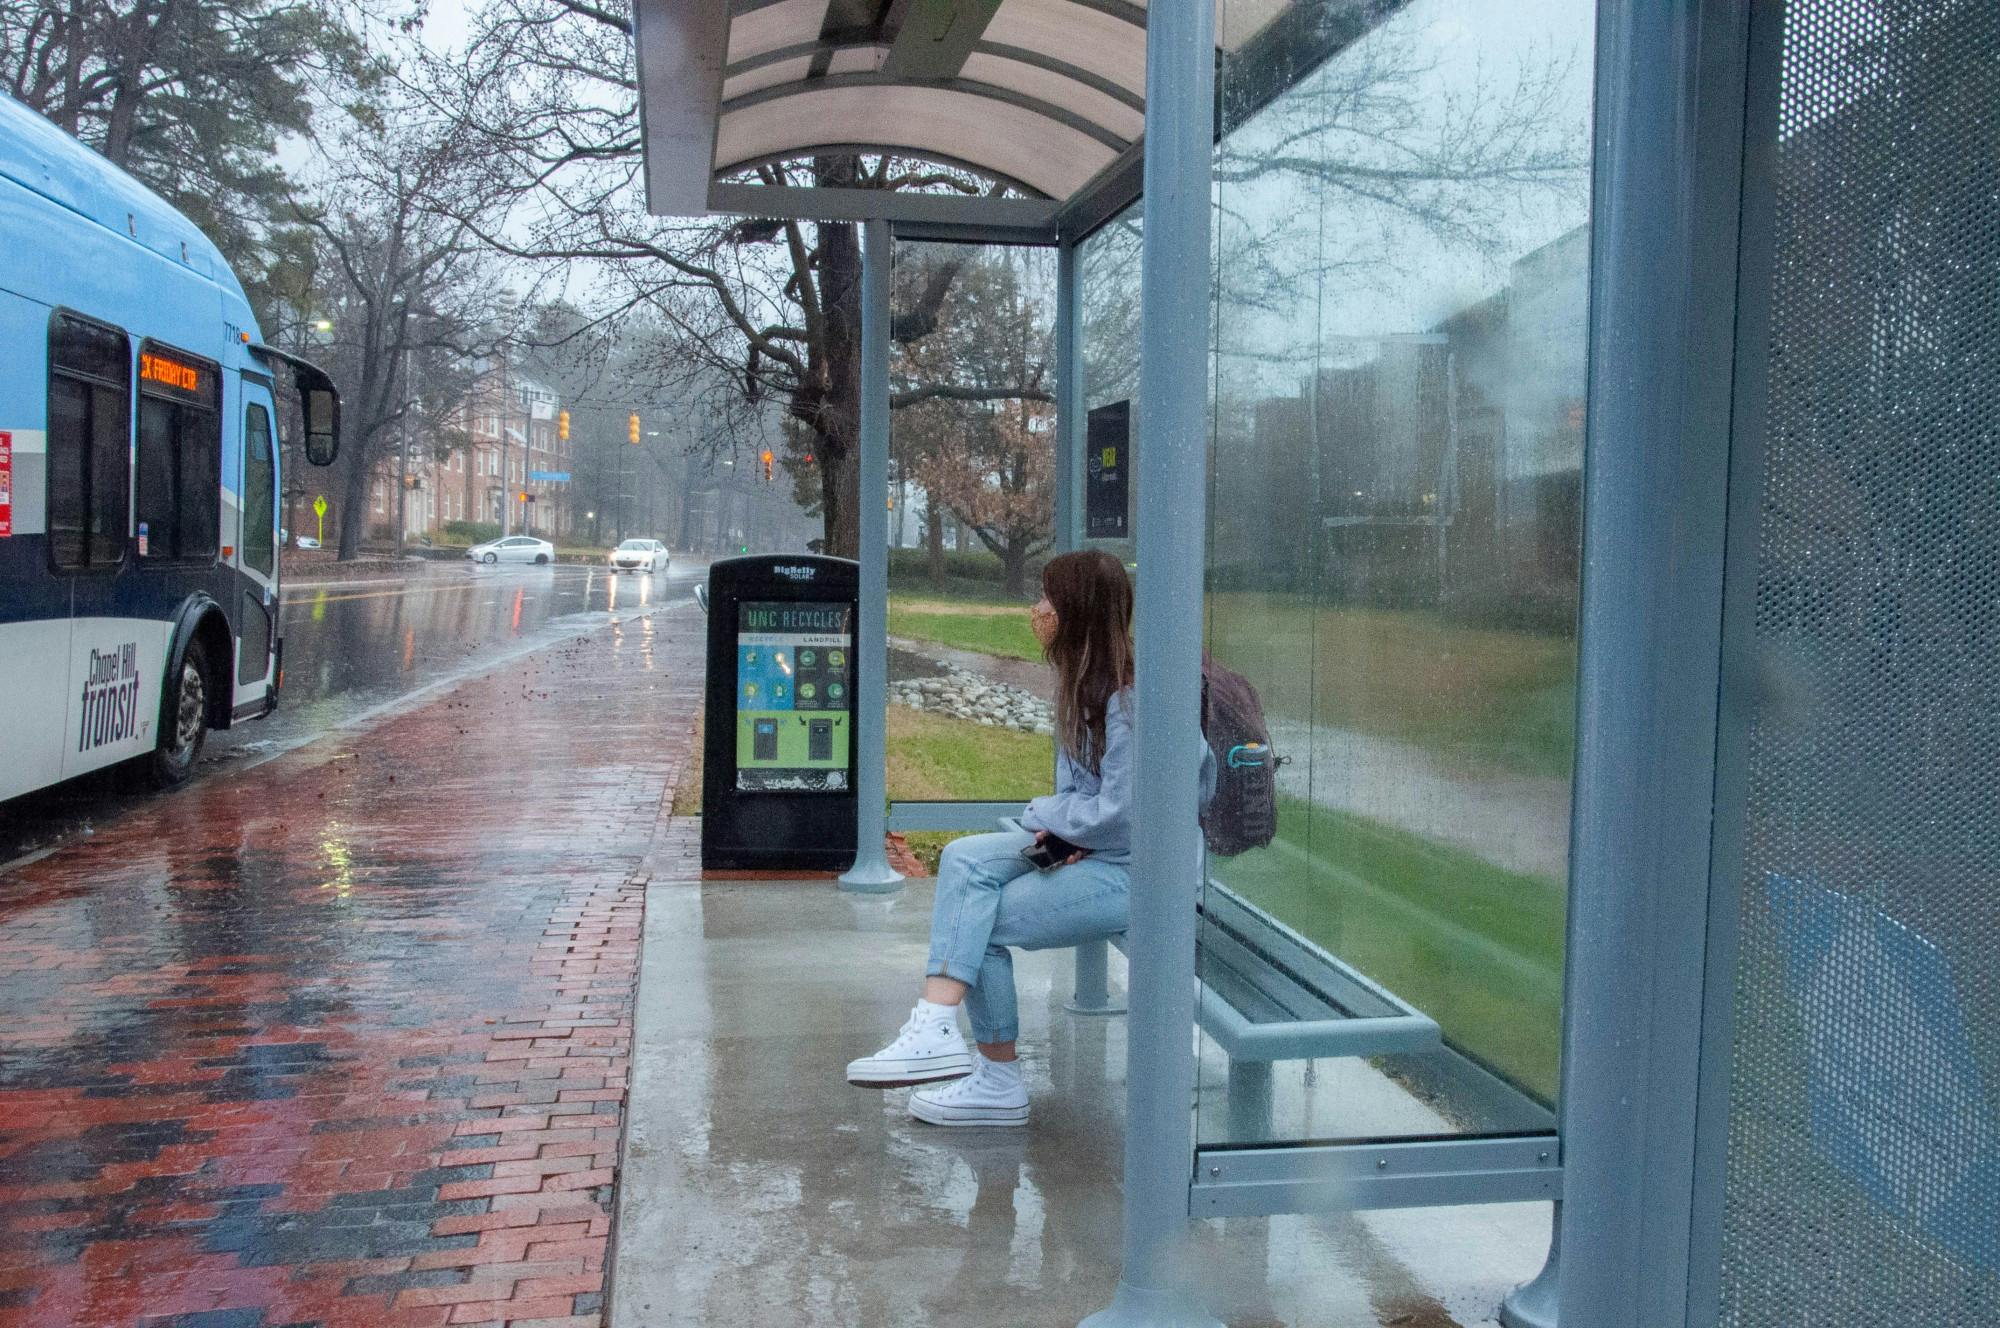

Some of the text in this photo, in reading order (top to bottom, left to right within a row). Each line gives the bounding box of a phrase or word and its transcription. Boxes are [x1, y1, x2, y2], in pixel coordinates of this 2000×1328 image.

[154, 358, 180, 386] FRIDAY
[182, 367, 196, 391] CTR
[774, 566, 816, 575] BigBelly
[749, 611, 841, 628] UNC RECYCLES
[89, 641, 136, 688] Chapel Hill
[79, 670, 139, 752] transit
